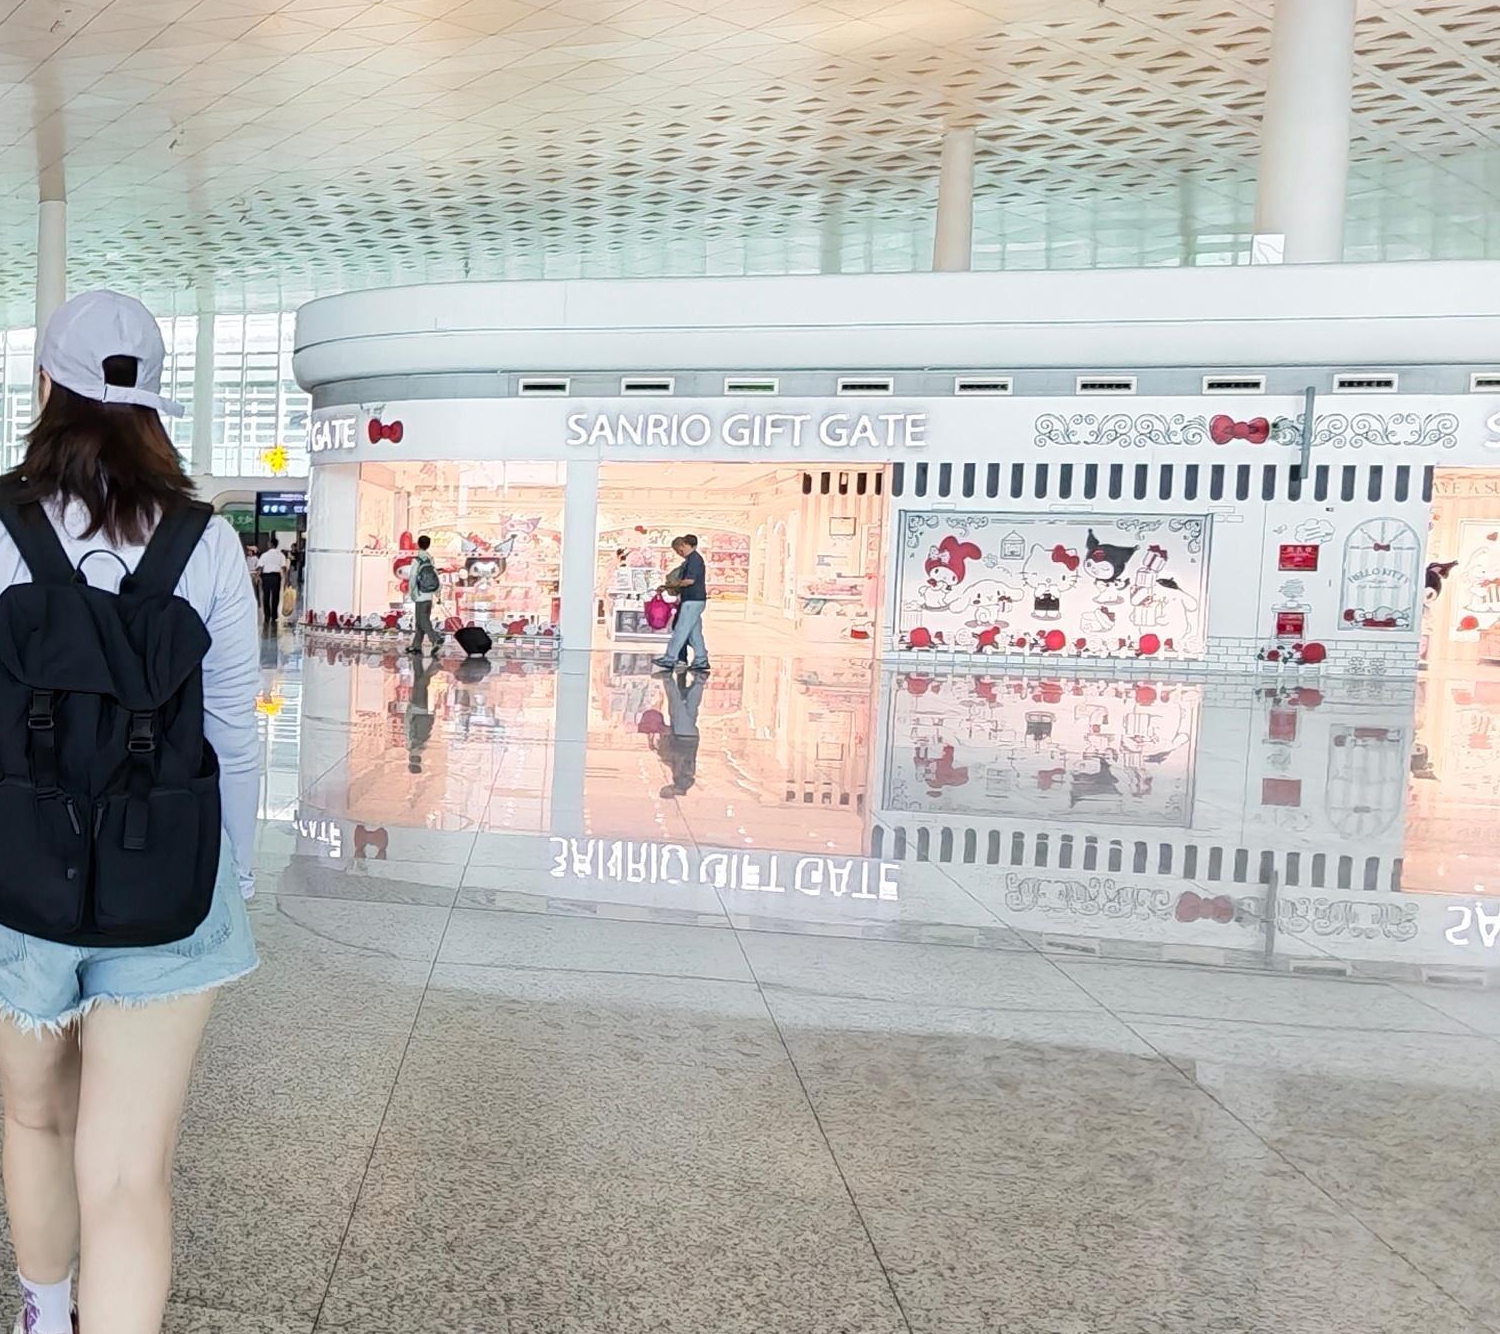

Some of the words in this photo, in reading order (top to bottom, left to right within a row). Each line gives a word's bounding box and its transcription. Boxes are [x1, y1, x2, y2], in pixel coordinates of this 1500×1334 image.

[311, 417, 357, 453] GATE
[565, 413, 711, 447] SANRIO
[722, 412, 812, 447] GIFT
[819, 412, 930, 447] GATE
